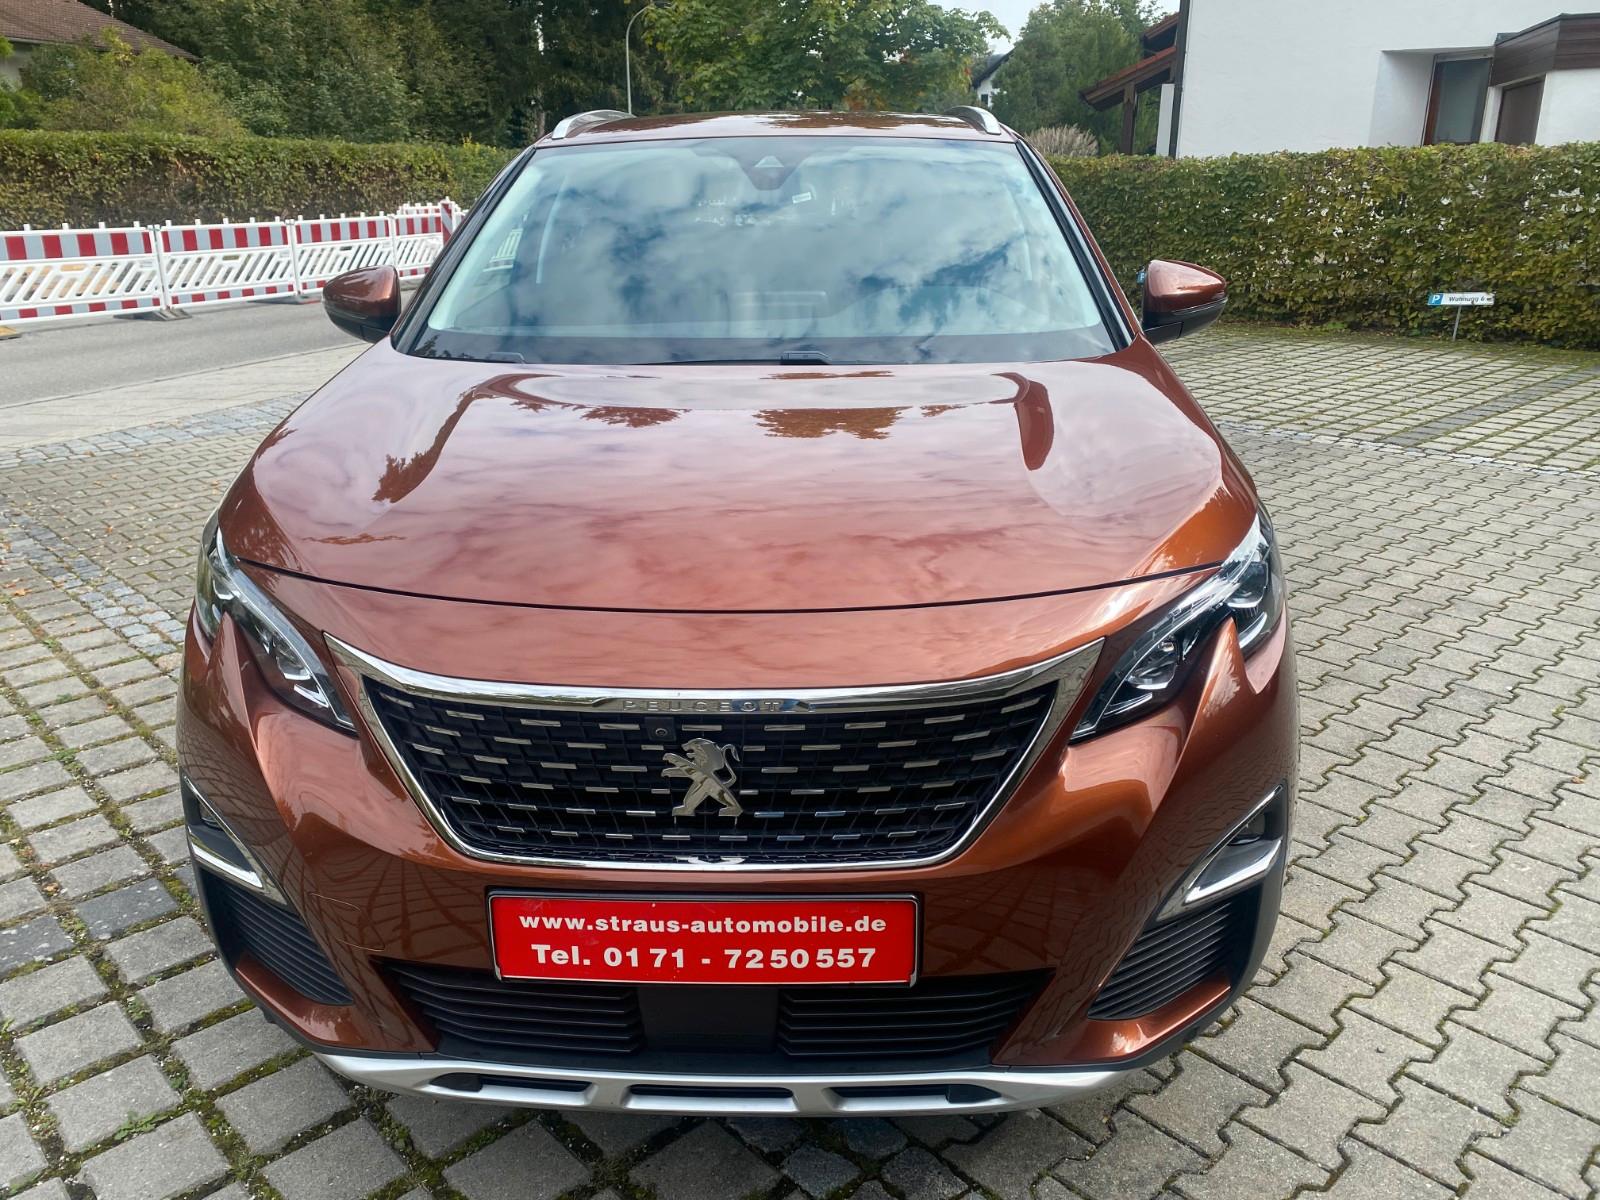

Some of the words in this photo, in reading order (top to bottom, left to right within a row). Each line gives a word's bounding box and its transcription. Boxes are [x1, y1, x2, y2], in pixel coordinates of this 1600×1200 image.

[1432, 294, 1441, 304] P
[622, 700, 780, 712] PEUGEOT
[519, 915, 887, 933] www.straus-automobile.de
[531, 943, 591, 966] Tel.
